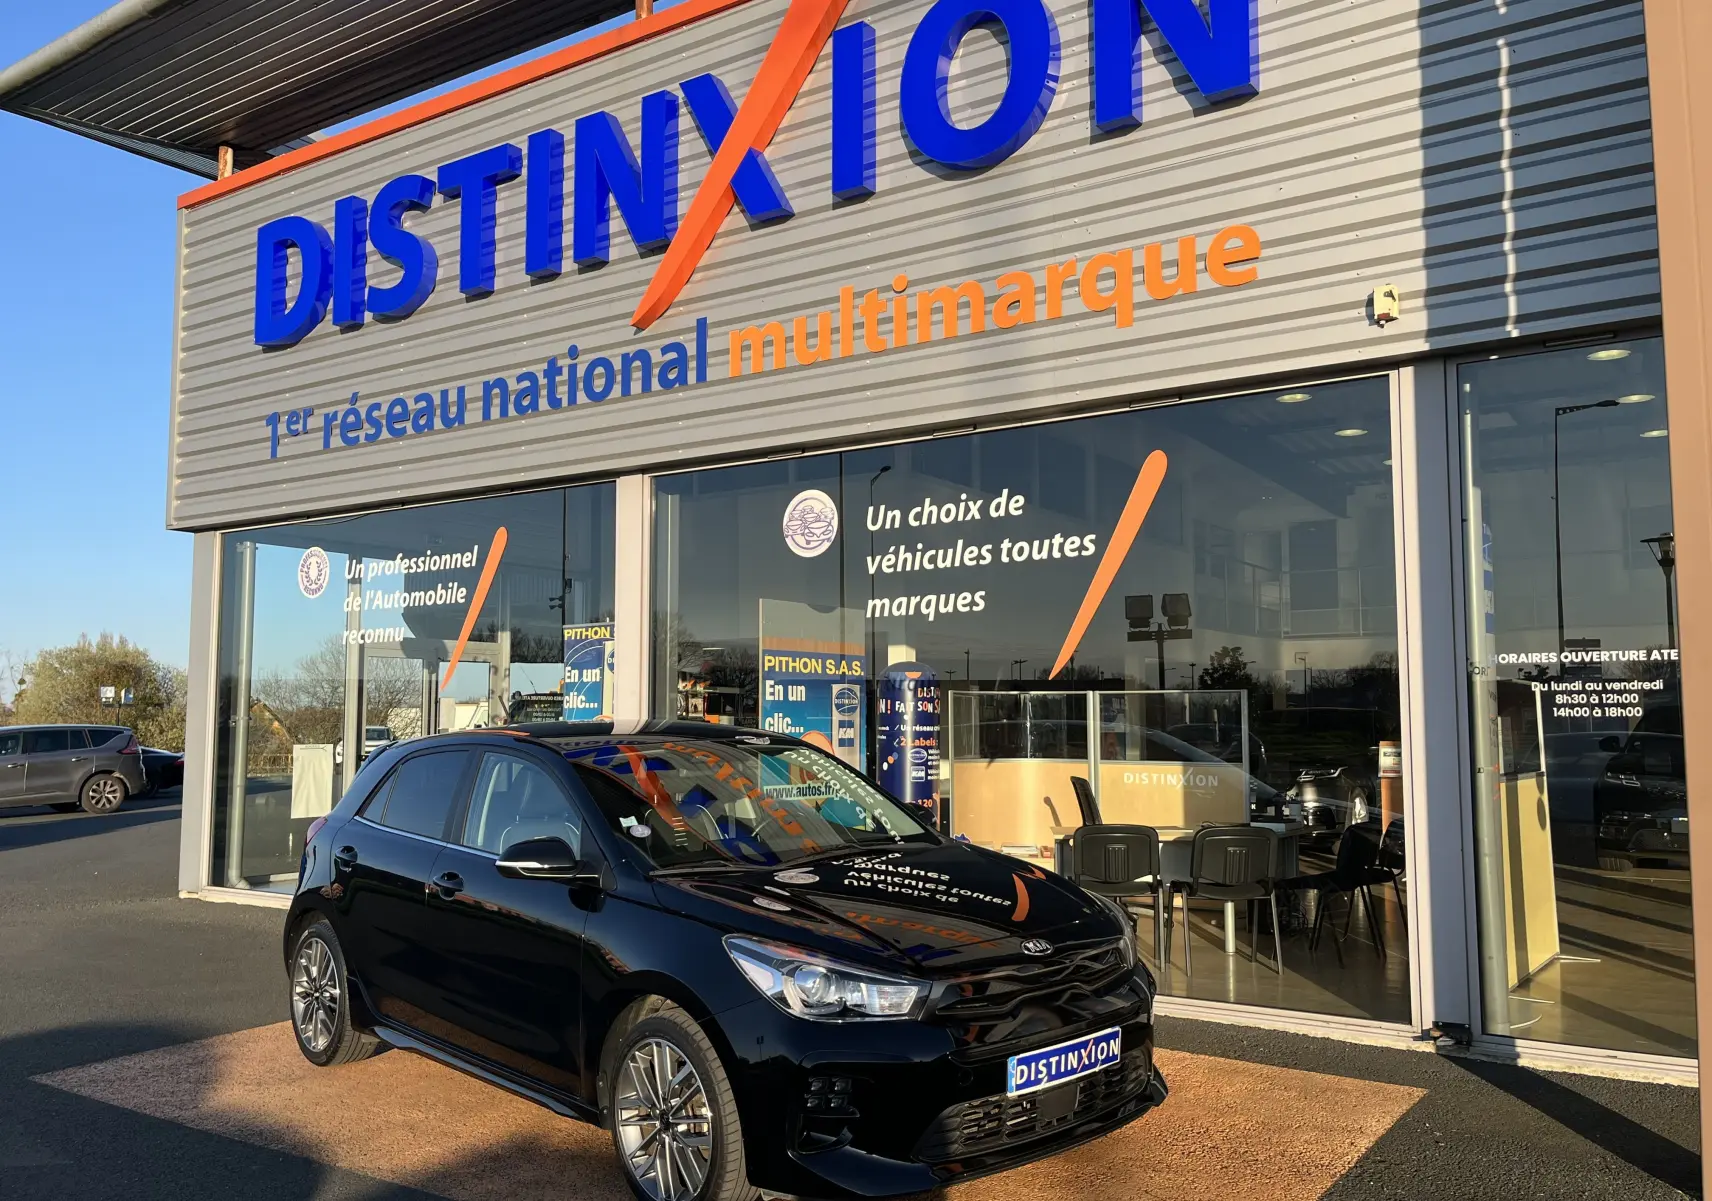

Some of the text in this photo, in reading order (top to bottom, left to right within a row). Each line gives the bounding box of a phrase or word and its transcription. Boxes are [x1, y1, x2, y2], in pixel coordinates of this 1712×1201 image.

[253, 0, 1261, 349] DISTINXION
[265, 223, 1263, 459] 1er réseau national multimarque
[865, 488, 1026, 531] Un choix de
[344, 544, 479, 583] Un professionnel
[866, 531, 1097, 575] véhicules toutes
[343, 582, 468, 613] de l'Automobile
[866, 589, 987, 622] marques
[342, 626, 405, 645] reconnu
[564, 626, 611, 641] PITHON
[764, 655, 865, 676] PITHON S.A.S.
[1560, 649, 1647, 663] OUVERTURE
[565, 666, 601, 683] En un
[1531, 679, 1663, 691] Du lundi au vendredi
[564, 692, 598, 709] clic...
[765, 679, 806, 701] En un
[1555, 693, 1639, 704] 8h30 à 12h00
[1552, 706, 1643, 717] 14h00 à 18h00
[765, 713, 804, 733] clic...
[1123, 767, 1219, 790] DISTINXION
[1015, 1038, 1119, 1086] DISTINXION
